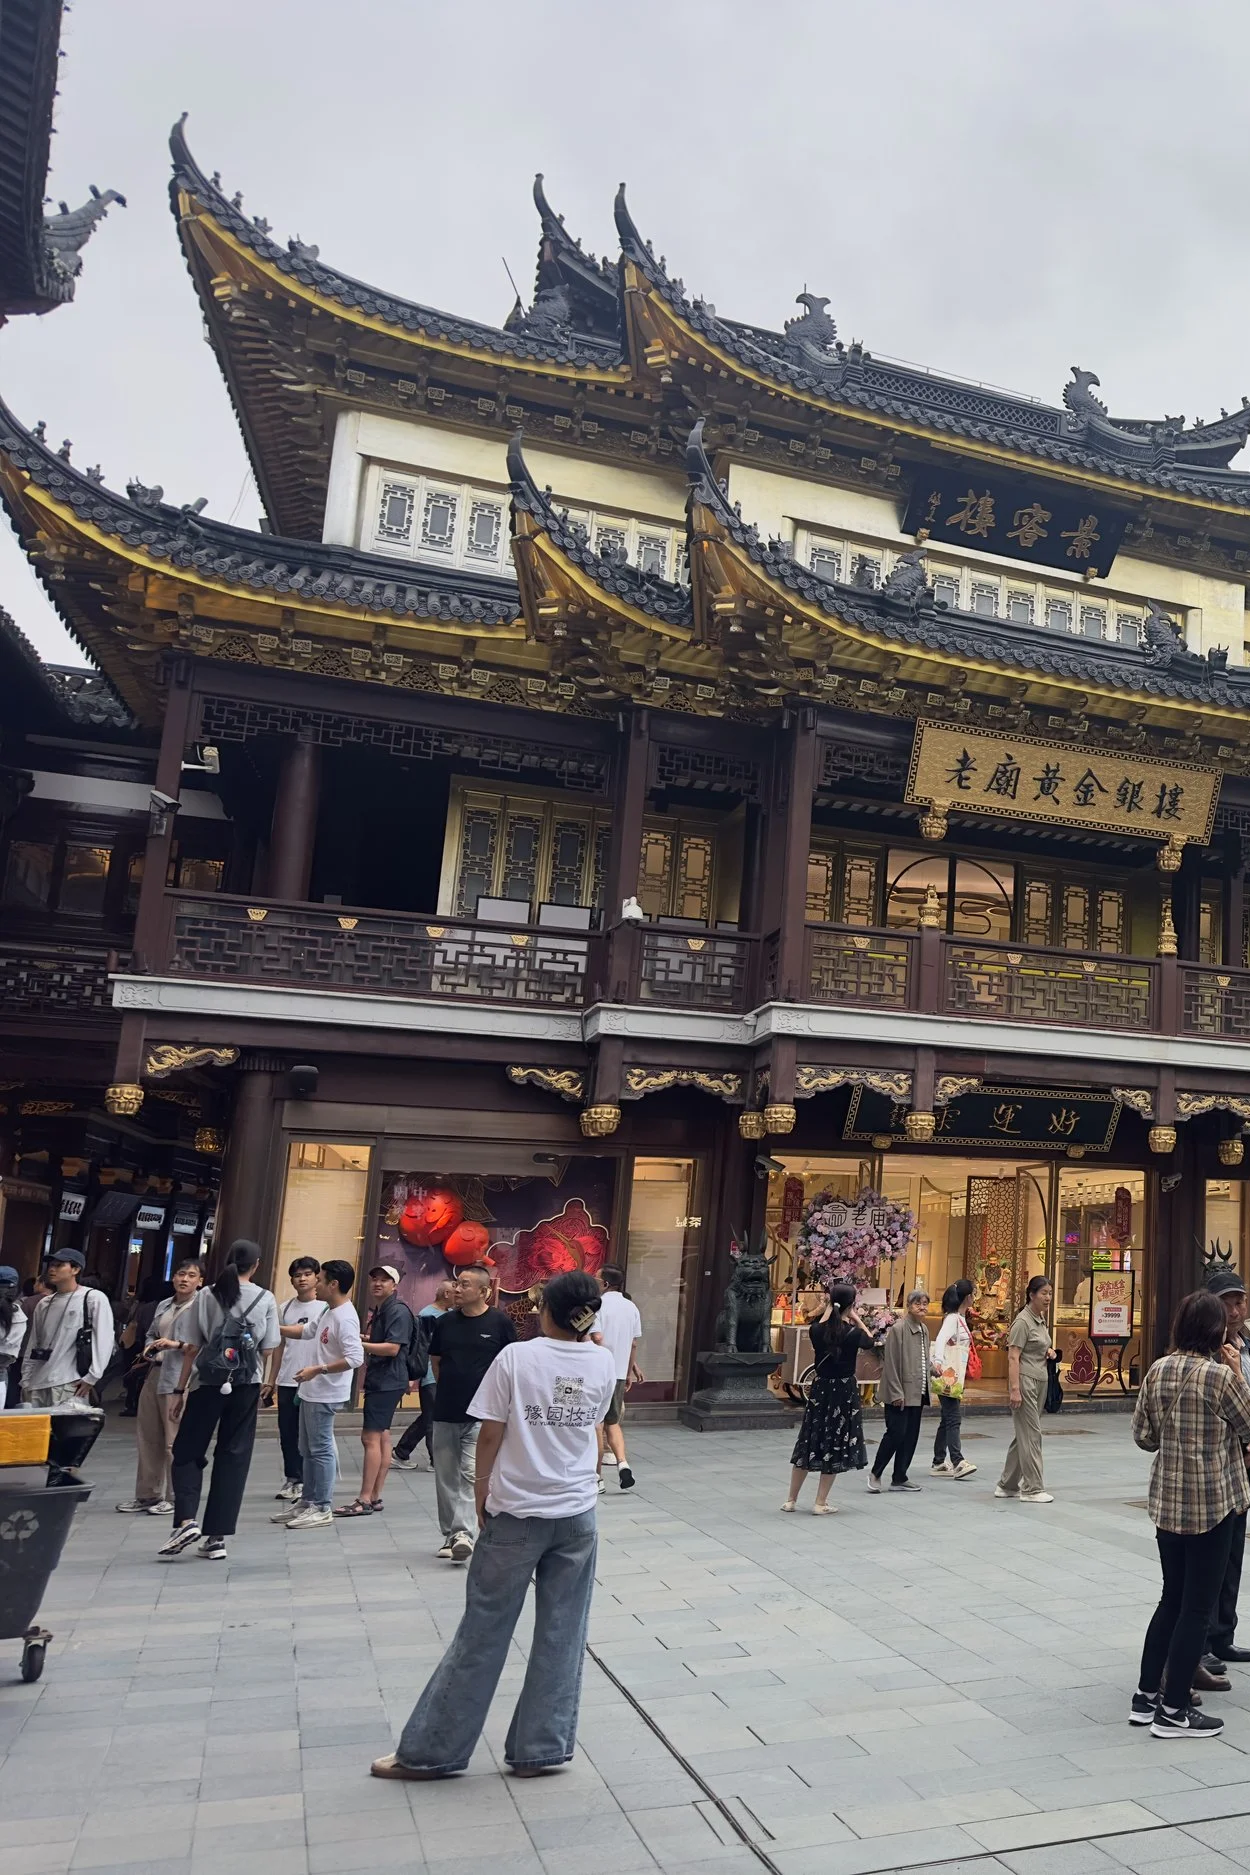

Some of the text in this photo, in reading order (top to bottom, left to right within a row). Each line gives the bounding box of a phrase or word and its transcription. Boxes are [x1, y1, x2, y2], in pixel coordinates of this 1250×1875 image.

[945, 748, 1185, 820] 老廟黃金銀樓
[851, 1206, 885, 1229] 老庙
[524, 1404, 598, 1421] 豫园妆造
